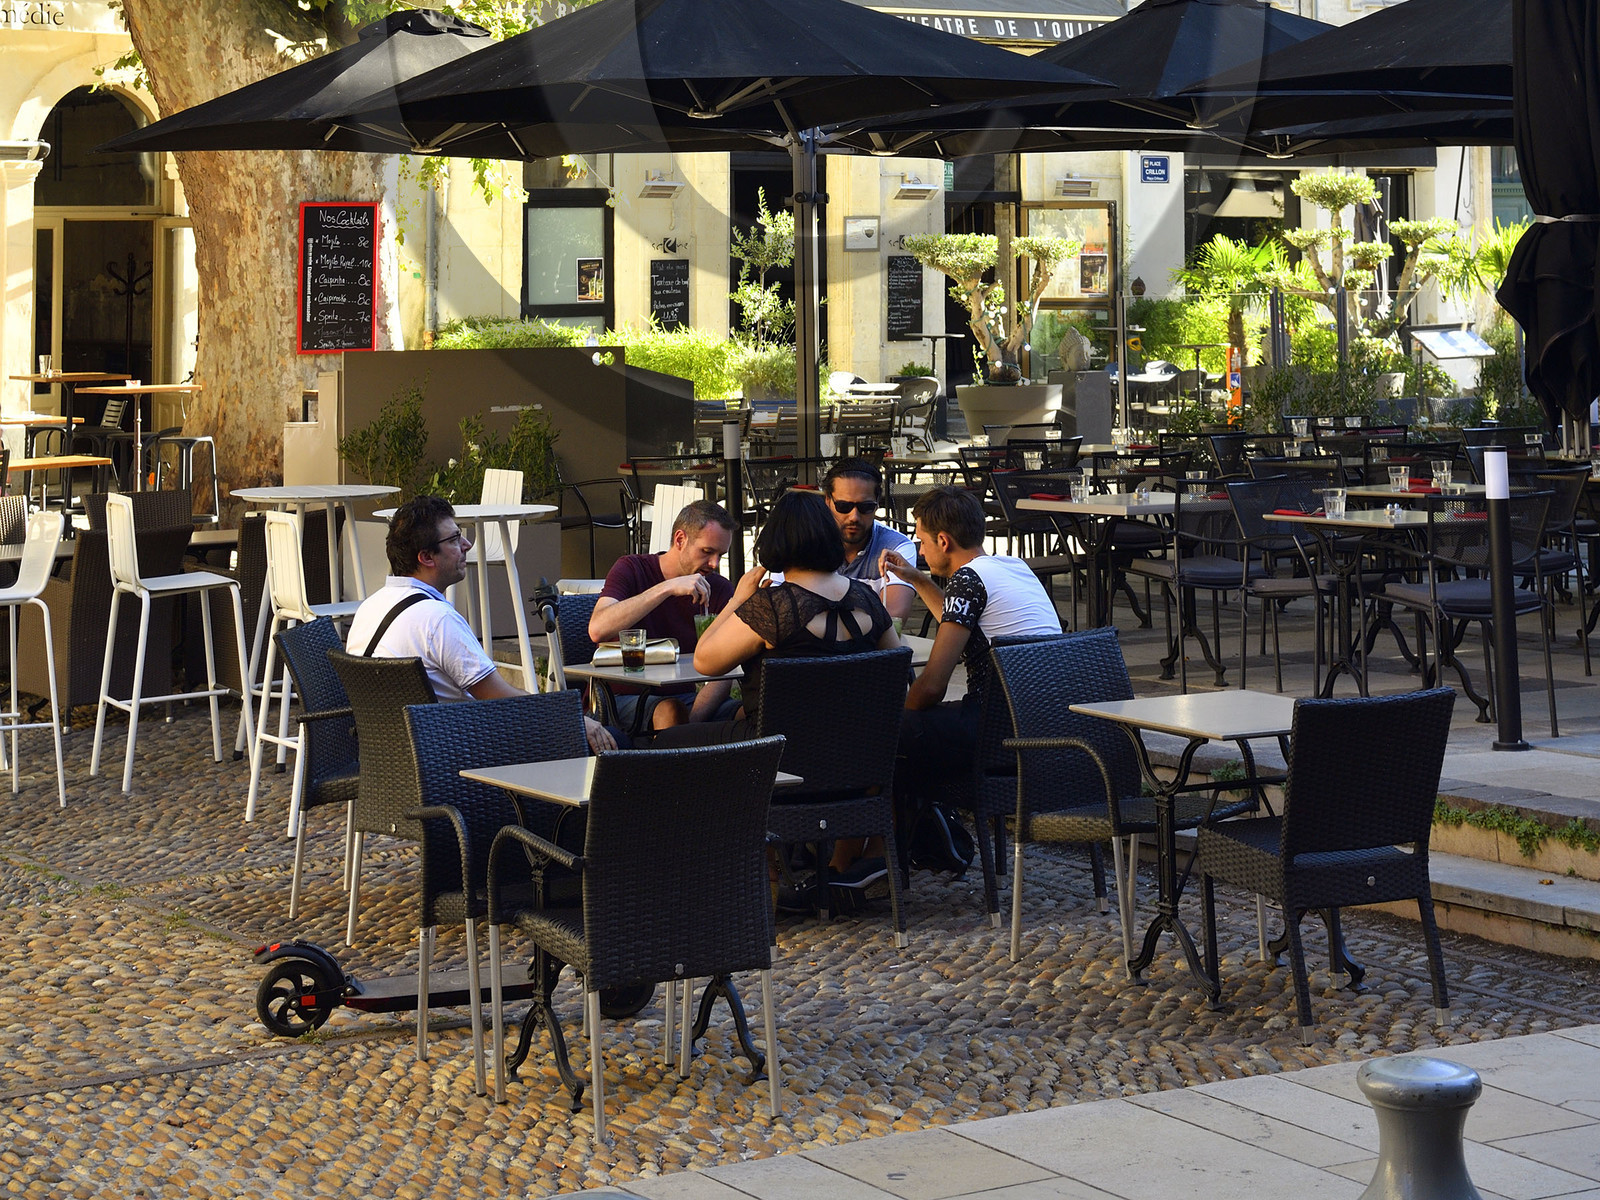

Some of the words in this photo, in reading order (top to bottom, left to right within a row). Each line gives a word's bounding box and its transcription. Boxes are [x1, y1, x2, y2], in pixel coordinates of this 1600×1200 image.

[896, 15, 979, 35] EATRE
[994, 19, 1018, 37] DE
[320, 209, 336, 224] Nos
[336, 210, 370, 226] Cocktails
